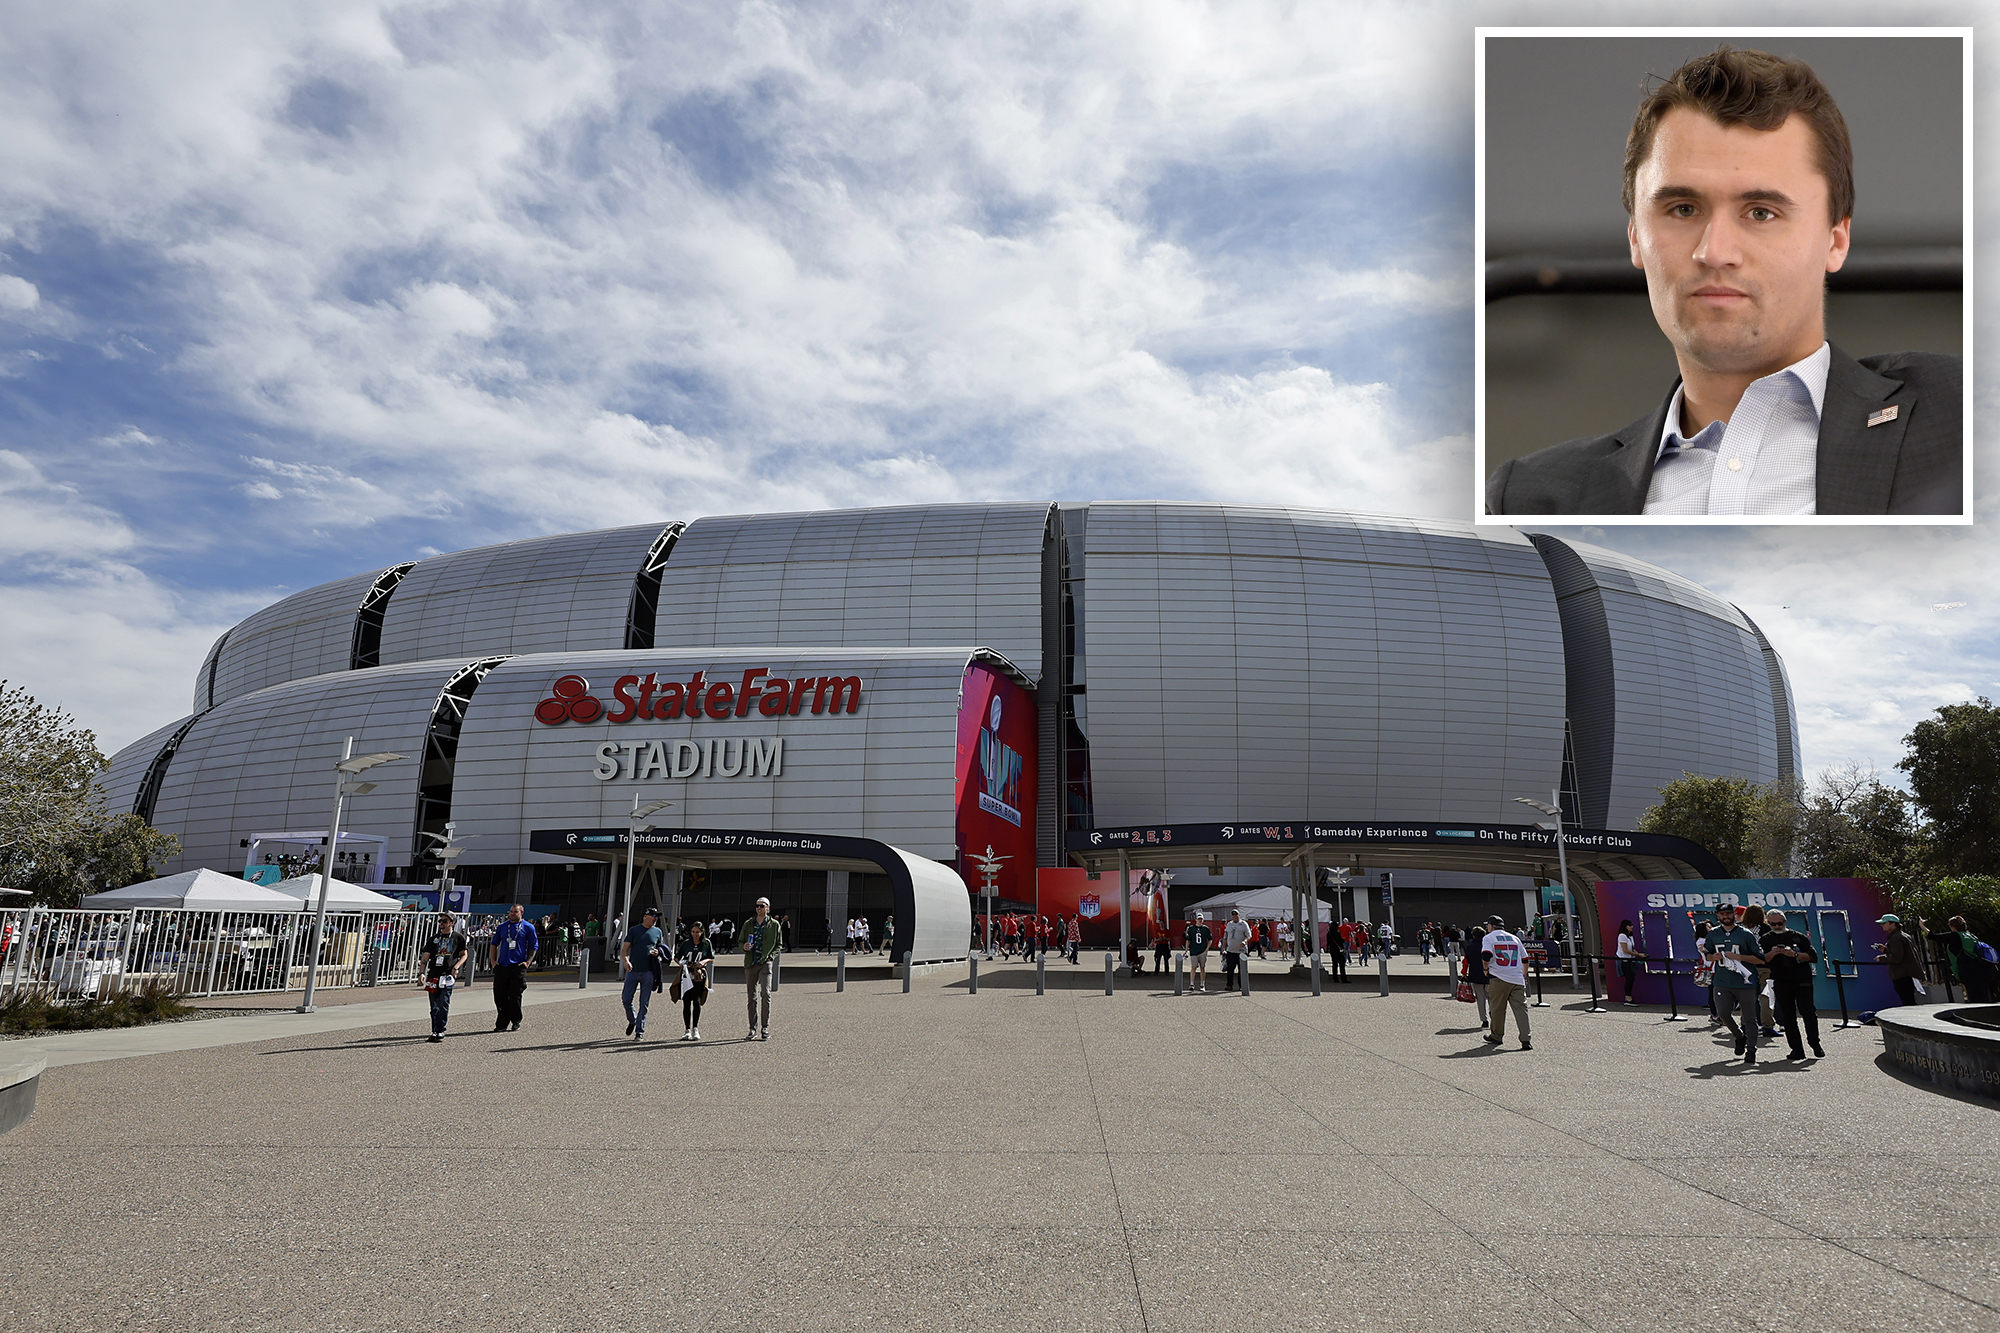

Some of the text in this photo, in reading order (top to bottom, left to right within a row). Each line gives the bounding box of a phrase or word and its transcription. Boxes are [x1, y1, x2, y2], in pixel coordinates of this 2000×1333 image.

[593, 737, 785, 781] STADIUM
[982, 797, 1019, 824] SUPER BOWL
[1162, 829, 1172, 841] 3
[1284, 827, 1294, 838] 1
[1314, 827, 1428, 838] Gameday Experience
[1479, 829, 1494, 840] On
[1497, 830, 1517, 840] The
[1521, 831, 1549, 843] Fifty
[1561, 833, 1604, 845] Kickoff
[1607, 836, 1632, 847] Club
[618, 834, 669, 843] Tochdown
[672, 834, 692, 843] Club
[701, 834, 722, 844] Club
[724, 836, 737, 844] 57
[746, 836, 798, 848] Champions
[800, 839, 822, 850] Club
[1647, 892, 1833, 907] SUPER BOWL
[1082, 903, 1098, 914] NFL
[1195, 933, 1202, 944] 6
[1494, 944, 1518, 967] 57
[1918, 1056, 1946, 1073] DEVILS
[1946, 1062, 1970, 1079] 1994
